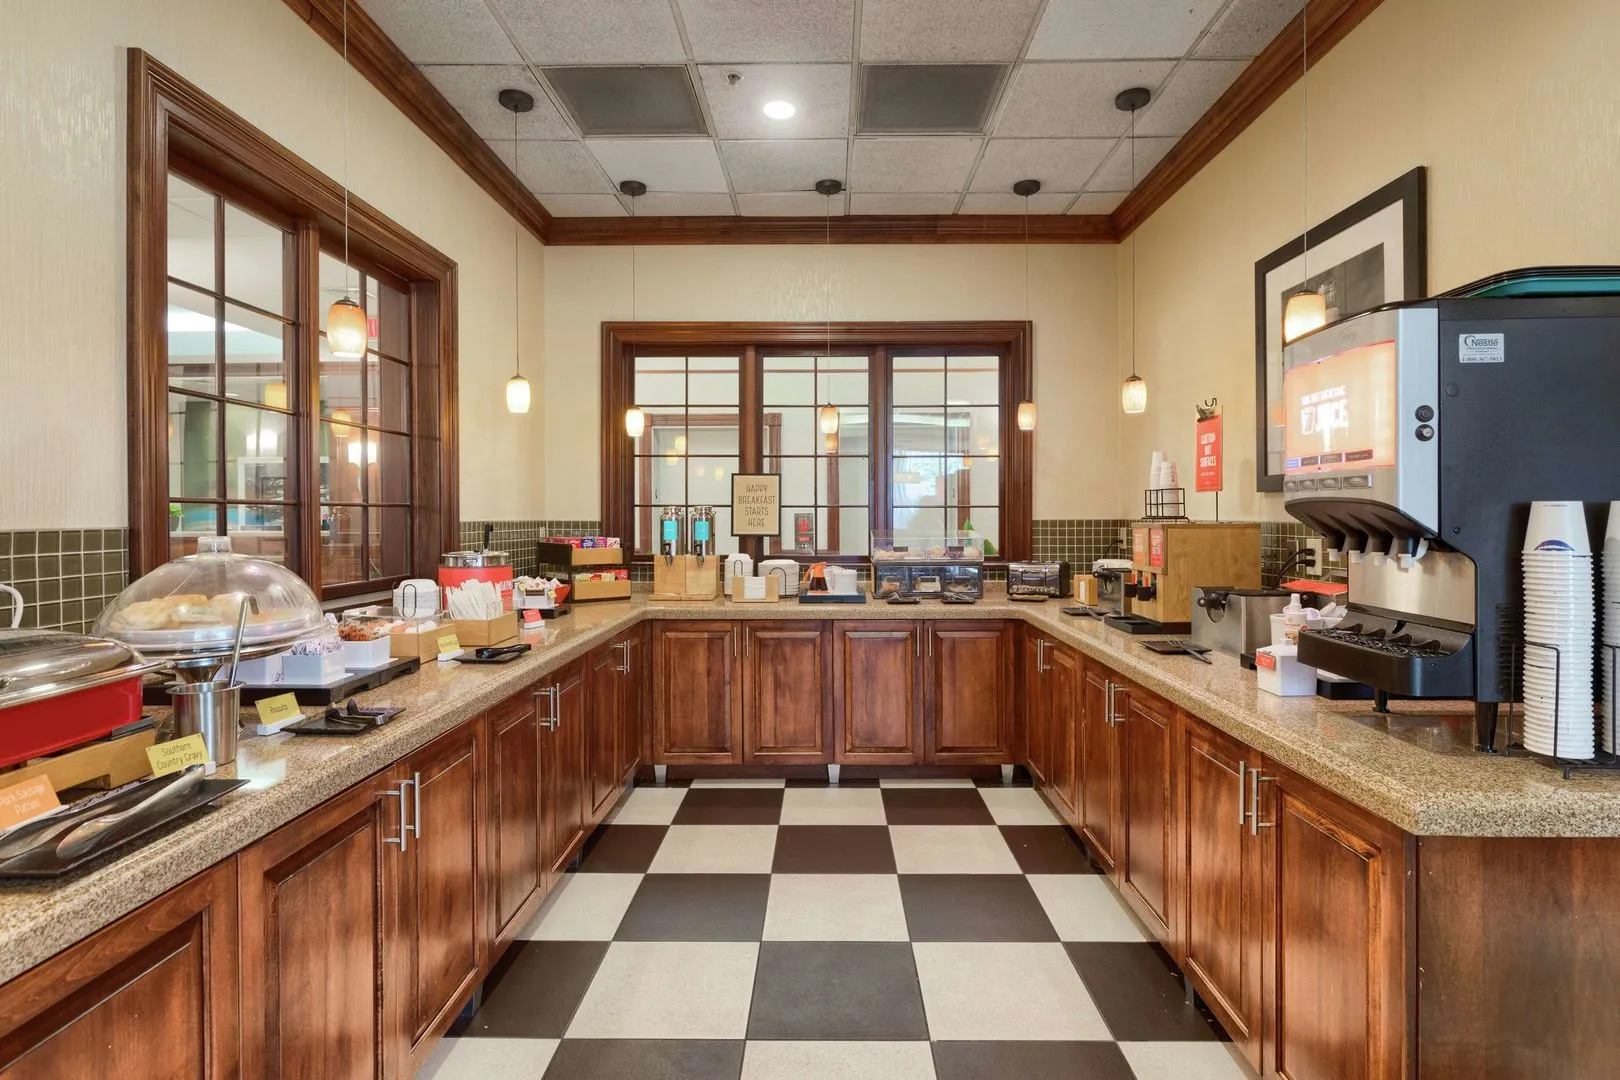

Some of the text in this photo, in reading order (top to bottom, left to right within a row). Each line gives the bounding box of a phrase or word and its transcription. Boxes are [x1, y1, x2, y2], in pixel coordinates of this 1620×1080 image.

[1471, 338, 1499, 347] Nestlé
[745, 484, 769, 493] HAPPY
[737, 495, 777, 505] BREAKFAST
[744, 506, 769, 516] STARTS
[747, 517, 767, 528] HERE
[161, 742, 193, 757] Southern
[156, 750, 203, 770] Country Gravy
